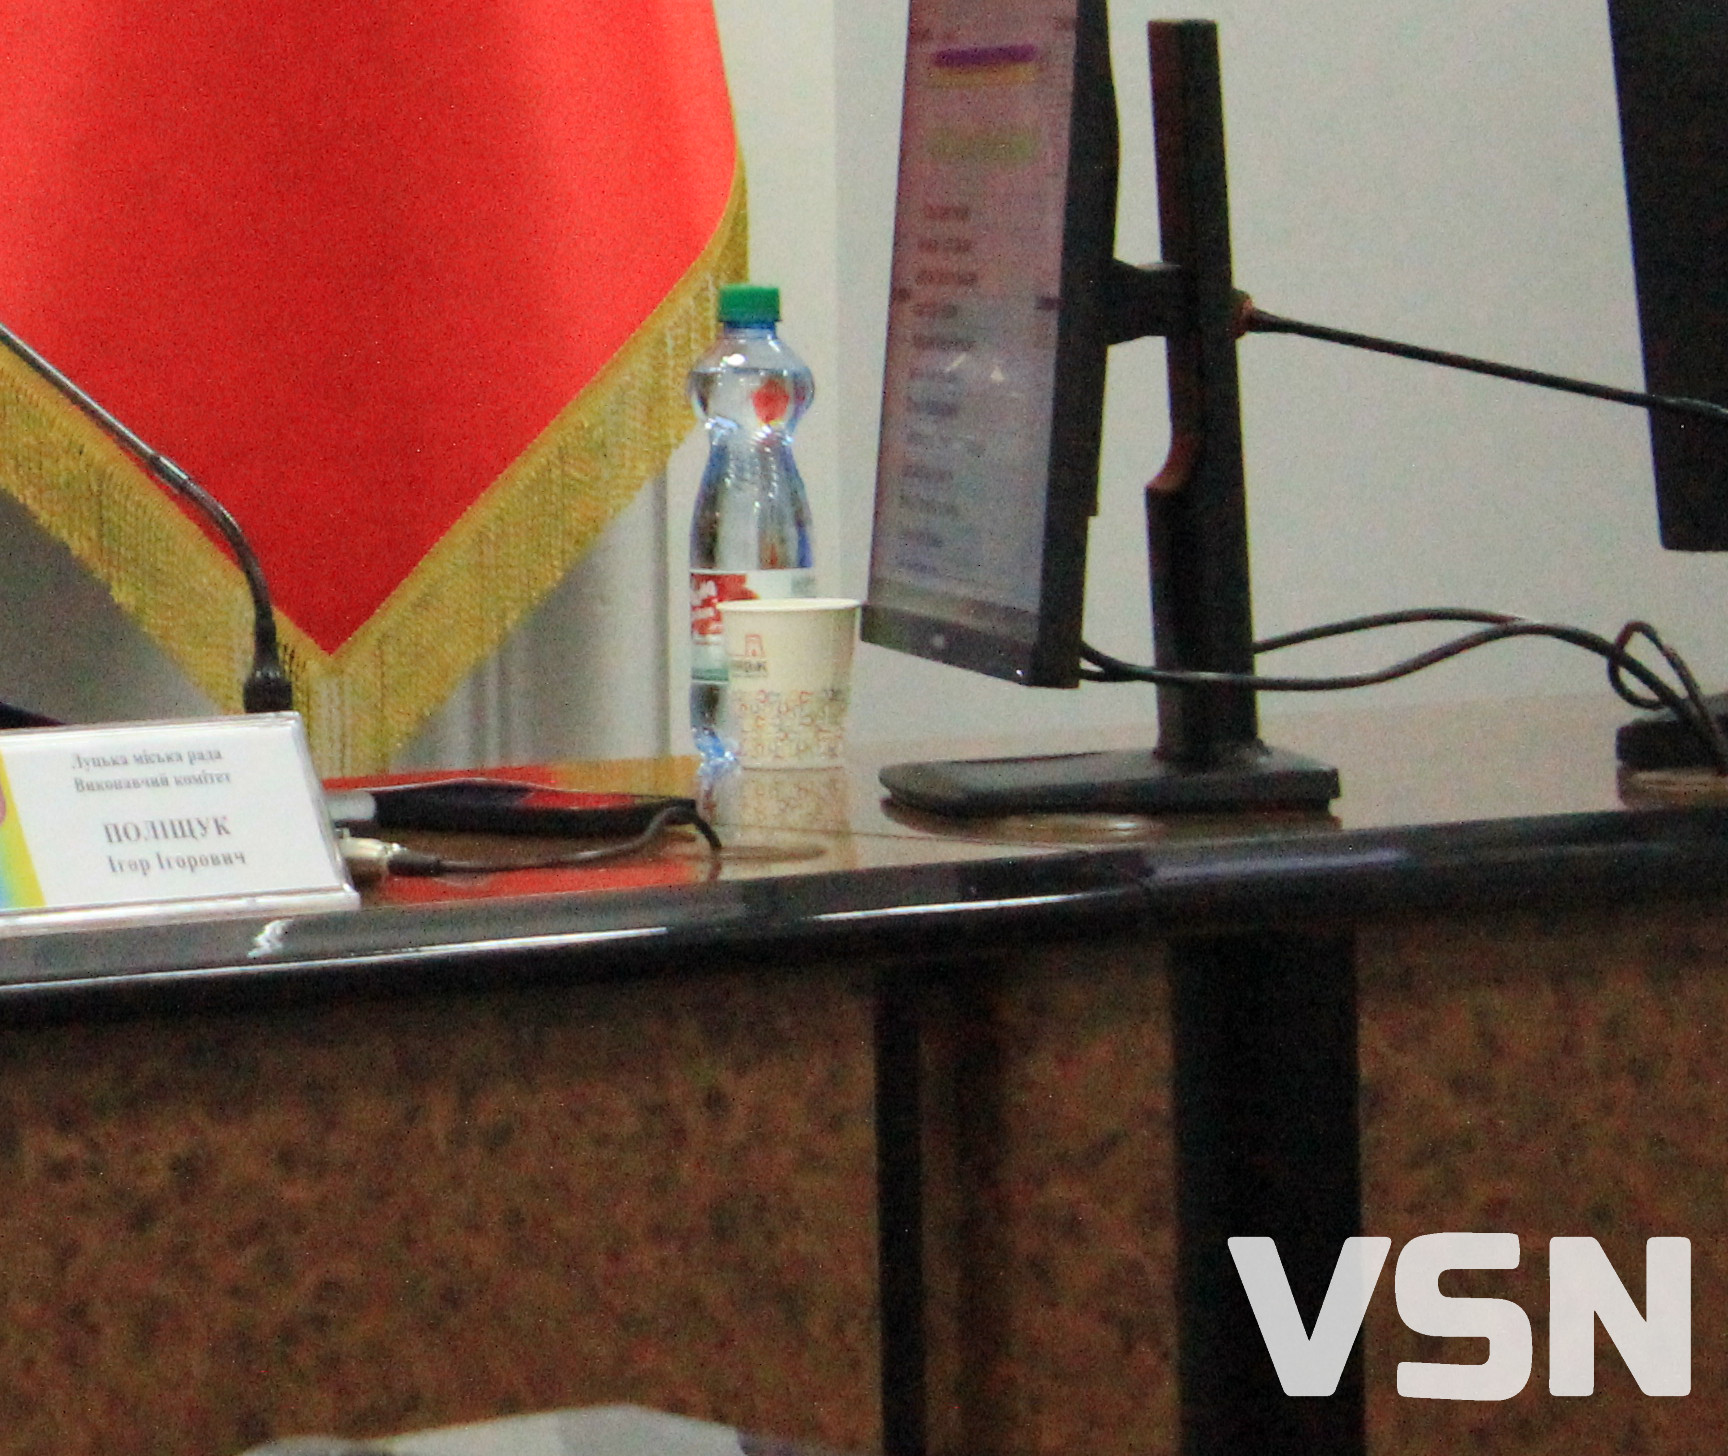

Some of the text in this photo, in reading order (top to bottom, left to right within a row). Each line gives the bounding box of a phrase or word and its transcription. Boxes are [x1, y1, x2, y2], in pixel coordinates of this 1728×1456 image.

[133, 749, 183, 765] міська
[187, 748, 223, 765] рада
[74, 769, 232, 793] Виконавчий комітет
[103, 815, 232, 844] ПОЛІЩУК
[107, 851, 247, 876] Ігор Ігорович
